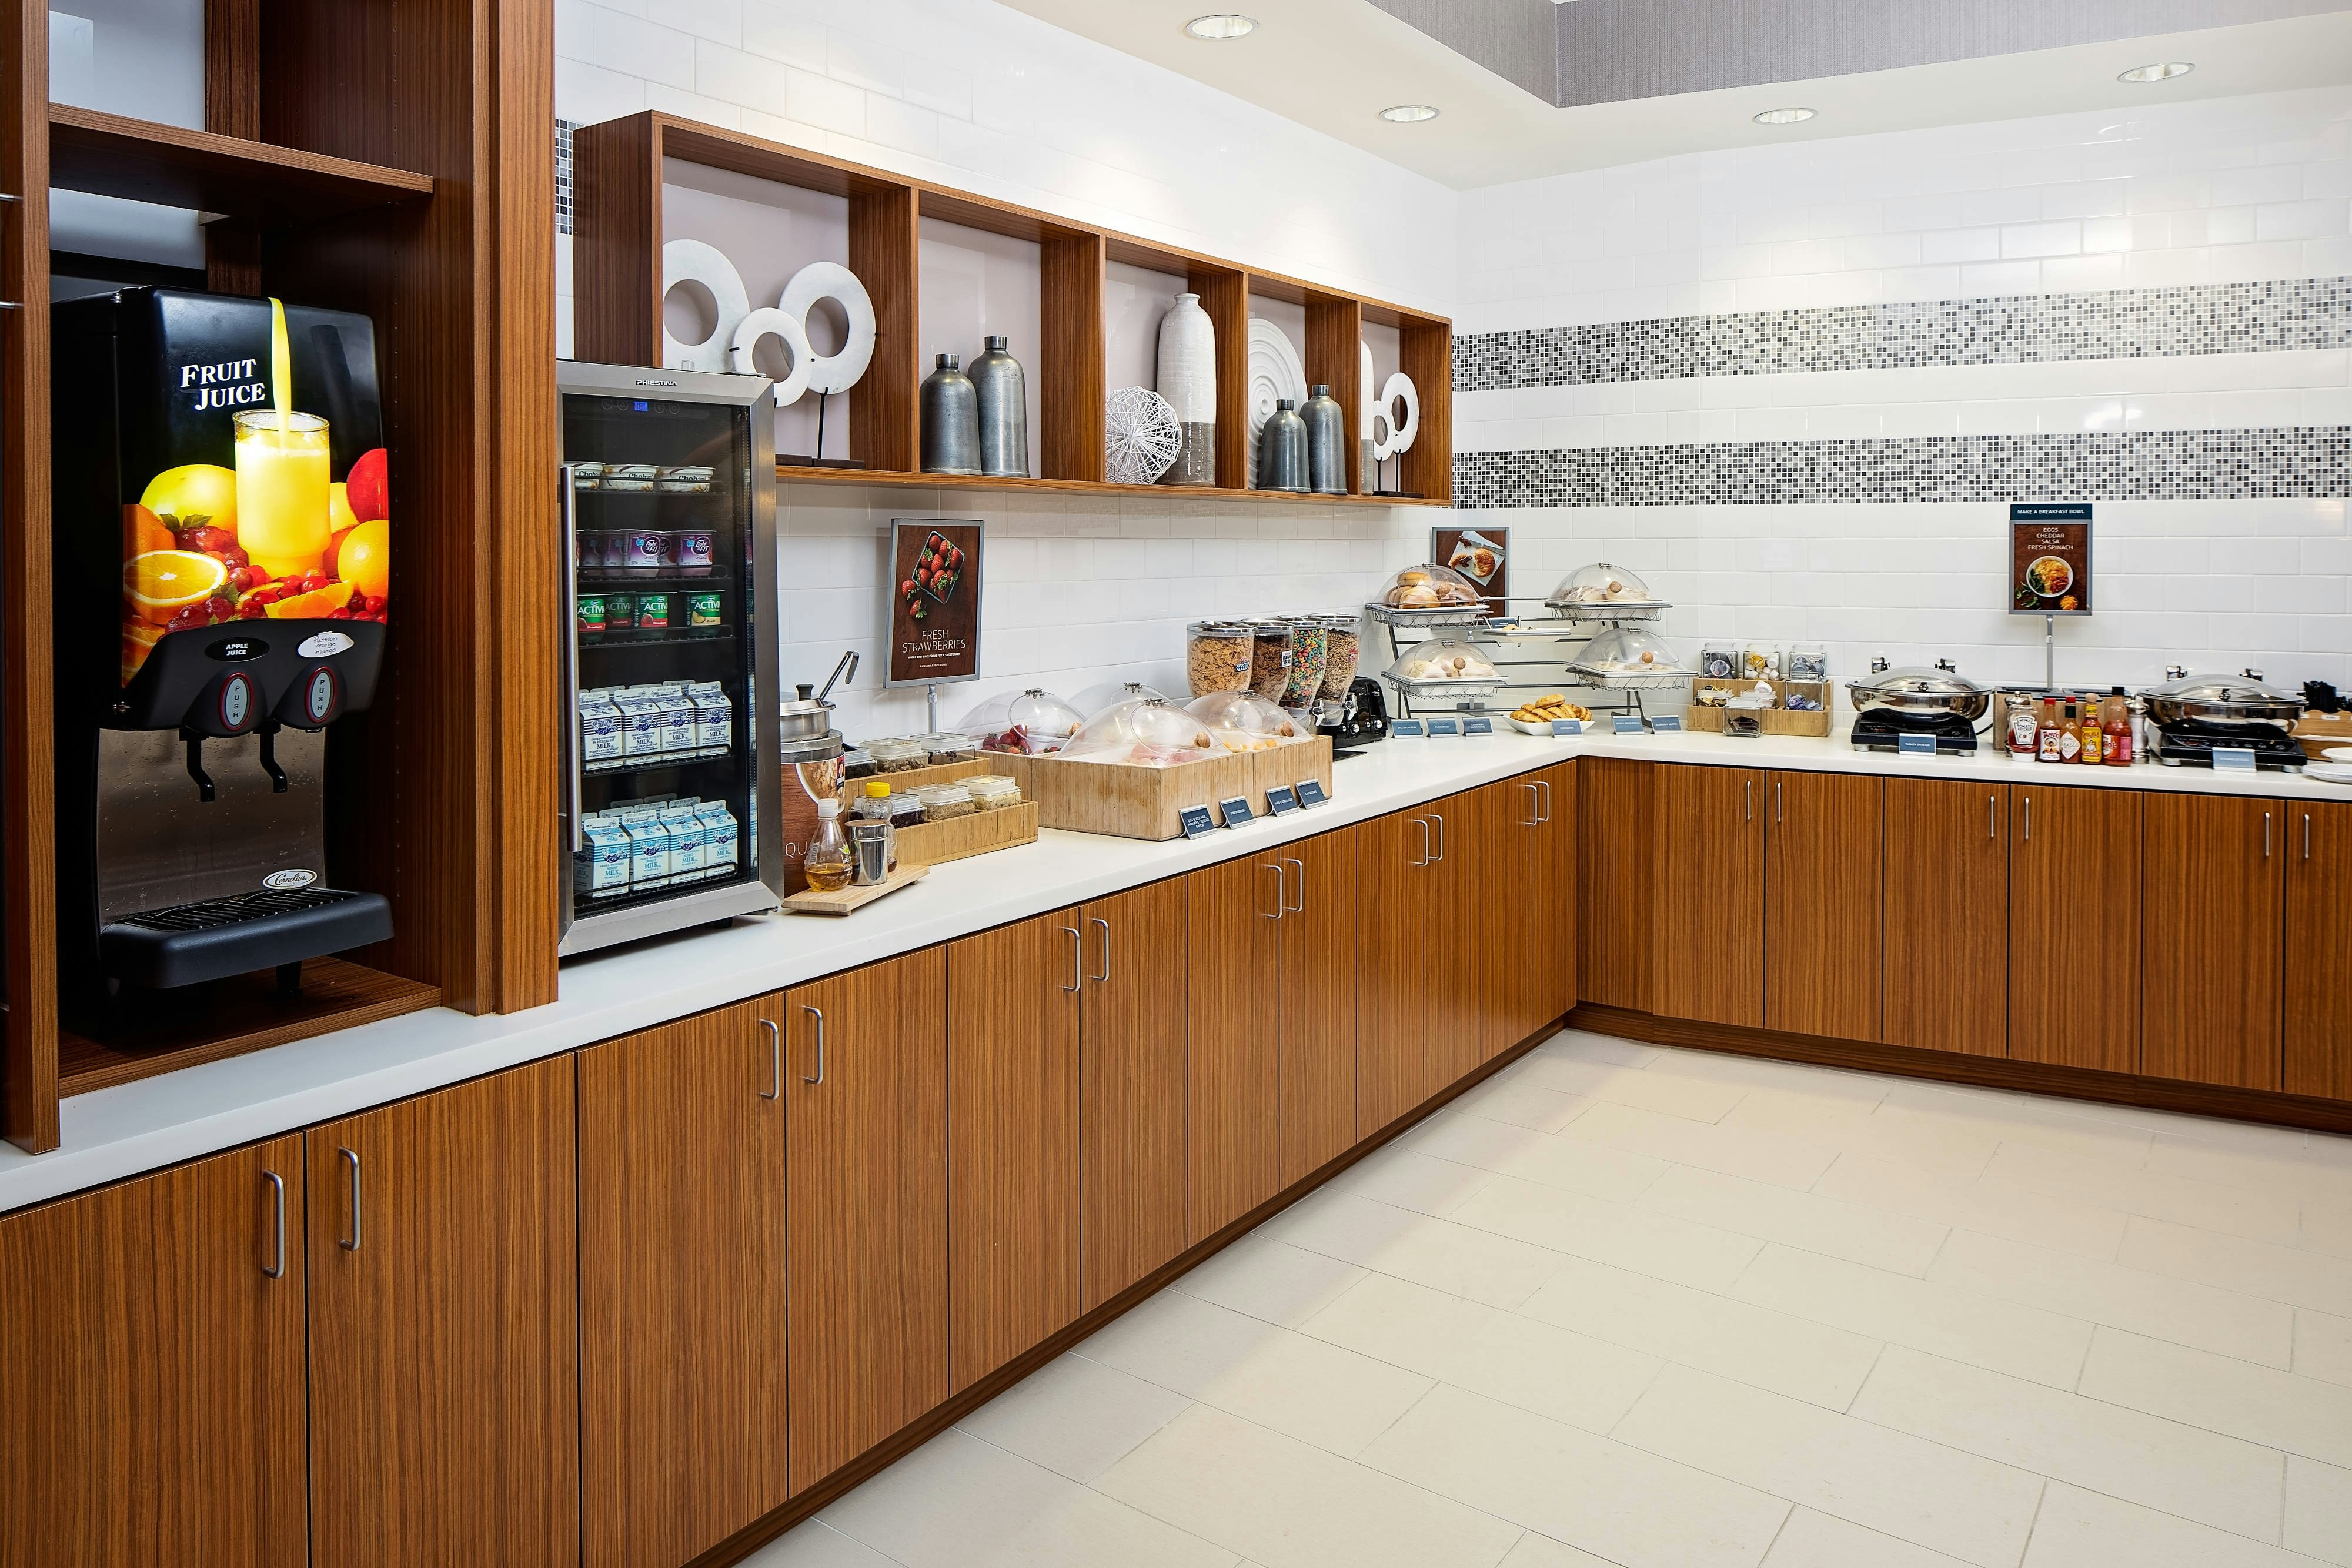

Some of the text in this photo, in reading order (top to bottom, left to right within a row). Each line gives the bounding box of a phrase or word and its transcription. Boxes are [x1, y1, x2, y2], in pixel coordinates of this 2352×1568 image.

[180, 359, 256, 387] FRUIT
[195, 382, 265, 410] JUICE
[922, 630, 948, 640] FRESH
[903, 639, 965, 653] STRAWBERRIES
[275, 872, 307, 885] Cornelius
